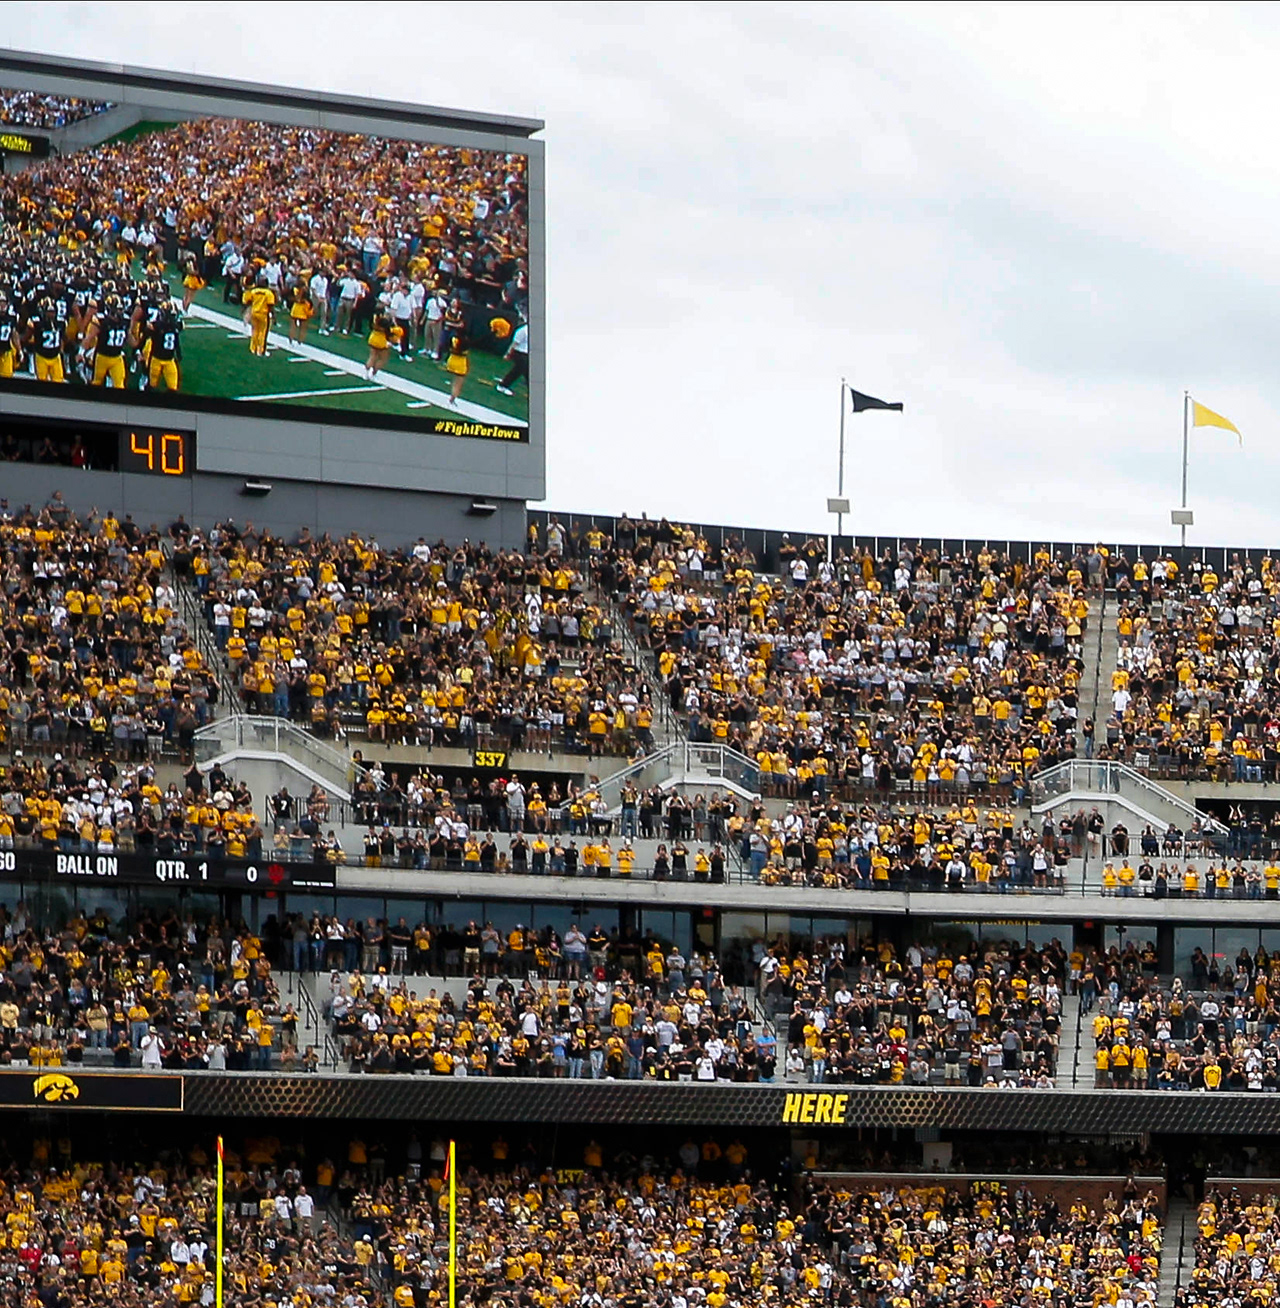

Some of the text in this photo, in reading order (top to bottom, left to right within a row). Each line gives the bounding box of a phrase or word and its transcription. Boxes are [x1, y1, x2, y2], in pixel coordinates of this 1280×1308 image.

[42, 331, 60, 348] 21
[164, 333, 175, 350] 8
[434, 421, 520, 440] #FightForIowa
[131, 432, 184, 475] 40
[476, 751, 505, 767] 337
[57, 854, 118, 876] BALL ON
[156, 860, 207, 880] QTR. 1
[247, 868, 257, 882] 0
[782, 1093, 848, 1123] HERE
